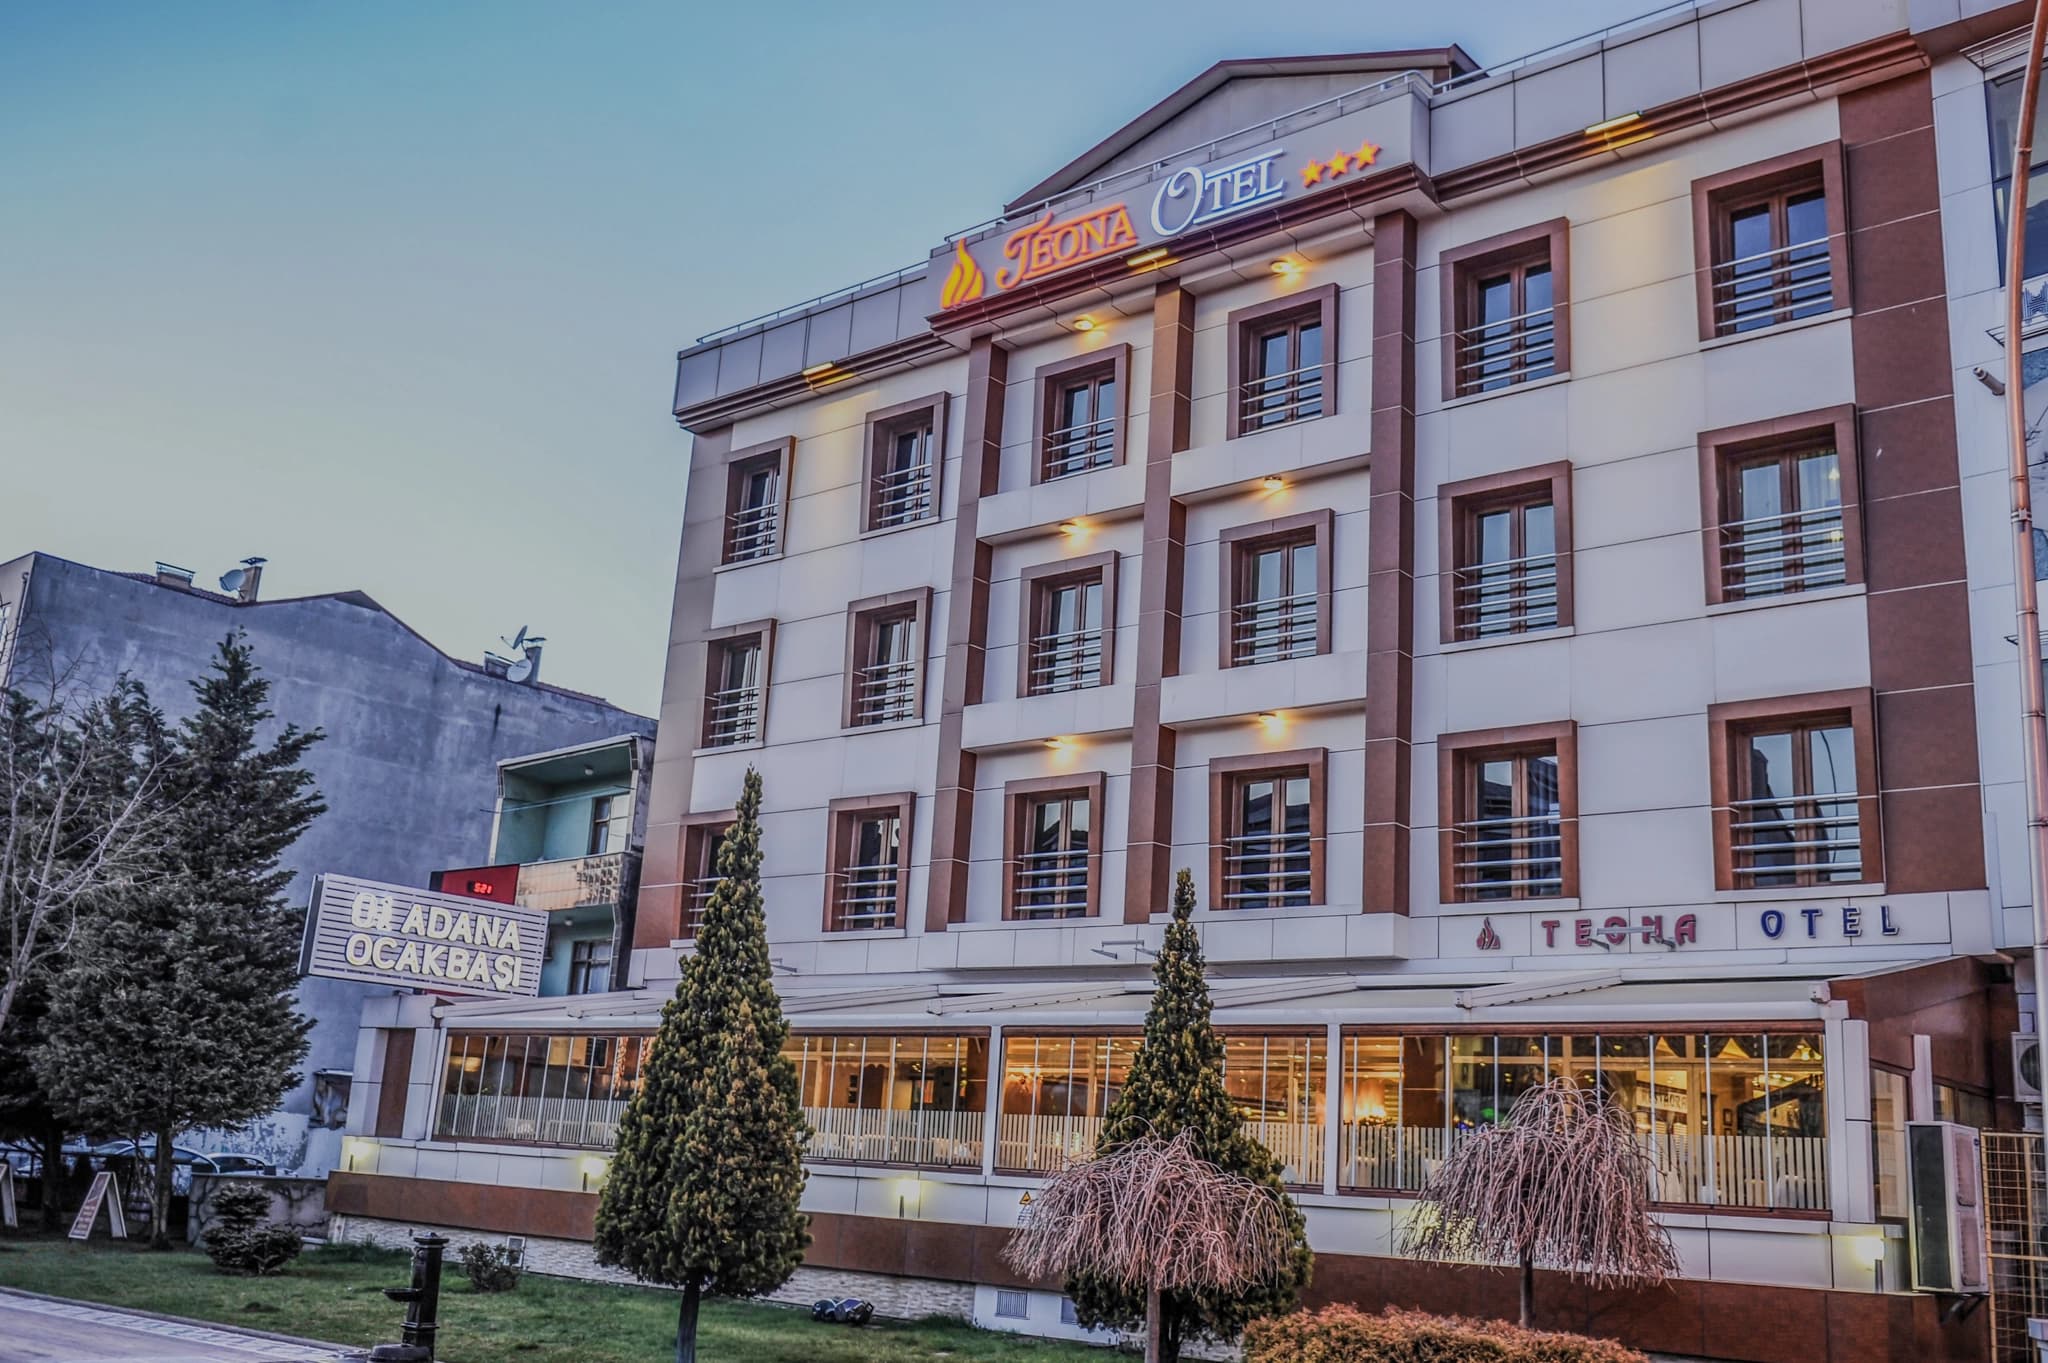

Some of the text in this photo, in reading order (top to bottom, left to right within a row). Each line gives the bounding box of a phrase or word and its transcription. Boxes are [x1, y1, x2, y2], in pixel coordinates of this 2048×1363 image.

[1151, 148, 1284, 237] OTEL
[401, 903, 521, 951] ADANA
[1541, 904, 1900, 948] TEONA OTEL
[346, 934, 522, 991] OCAKBAŞI
